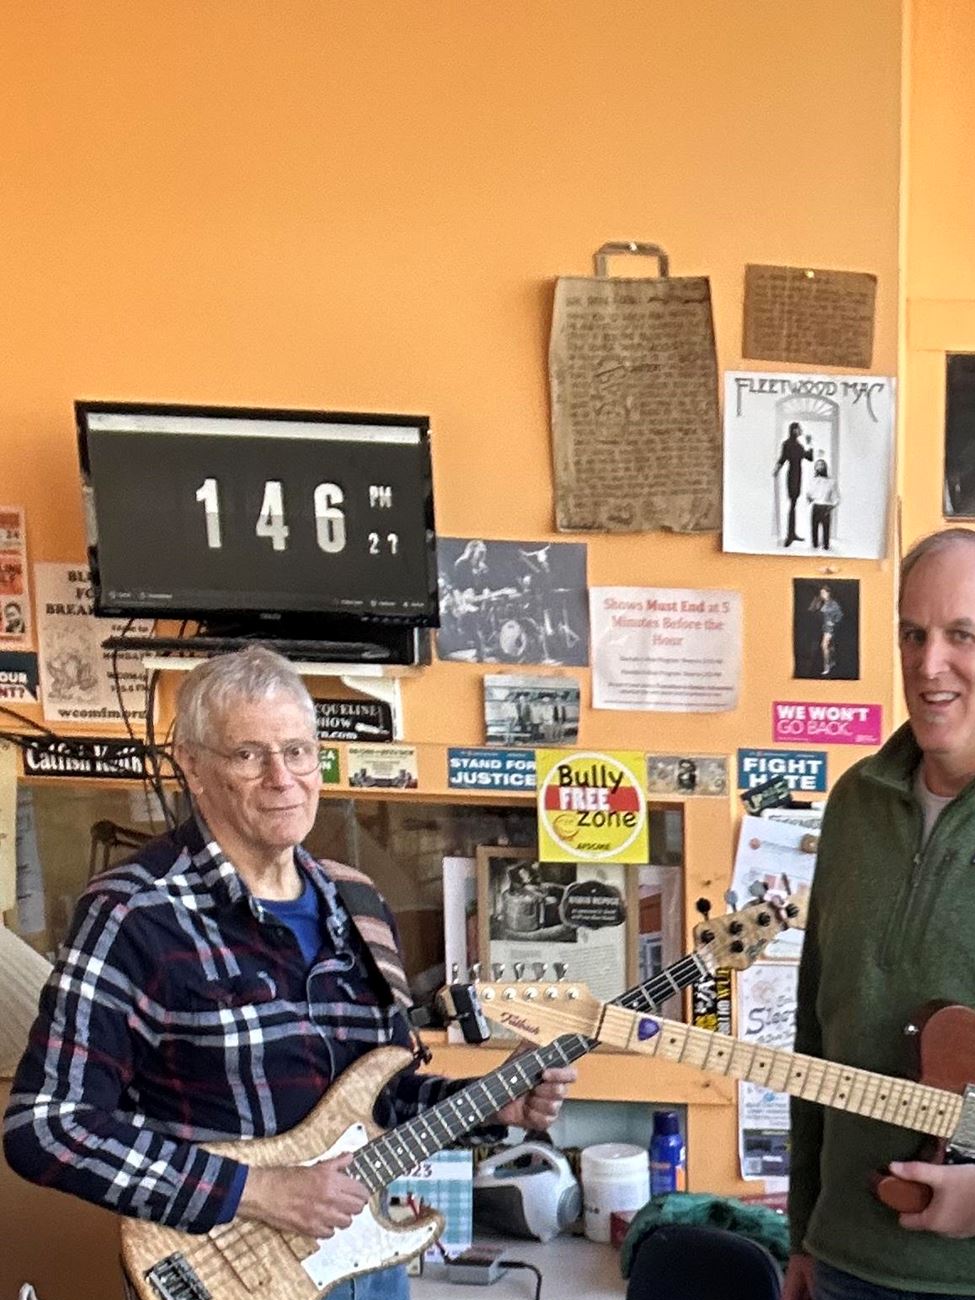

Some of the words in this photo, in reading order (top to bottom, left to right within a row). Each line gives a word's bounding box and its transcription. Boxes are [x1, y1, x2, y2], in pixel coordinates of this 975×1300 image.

[735, 378, 838, 417] FLEETWOOD
[840, 382, 885, 423] MAC
[369, 485, 392, 508] PM
[604, 598, 643, 610] Shows
[646, 600, 678, 612] Must
[680, 601, 705, 613] End
[708, 603, 719, 613] at
[612, 615, 660, 629] Minutes
[662, 617, 702, 630] Before
[704, 620, 725, 631] the
[653, 634, 684, 646] Hour
[58, 707, 147, 720] wcomfmorg
[776, 704, 806, 719] WE
[808, 706, 870, 721] WON'T
[776, 720, 805, 734] GO
[807, 720, 853, 736] BACK
[450, 757, 503, 770] STAND
[506, 759, 536, 771] FOR
[743, 757, 823, 775] FIGHT
[450, 771, 536, 787] JUSTICE
[558, 763, 624, 793] Bully
[749, 773, 817, 790] HTE
[559, 786, 611, 811] FREE
[577, 811, 637, 828] zone
